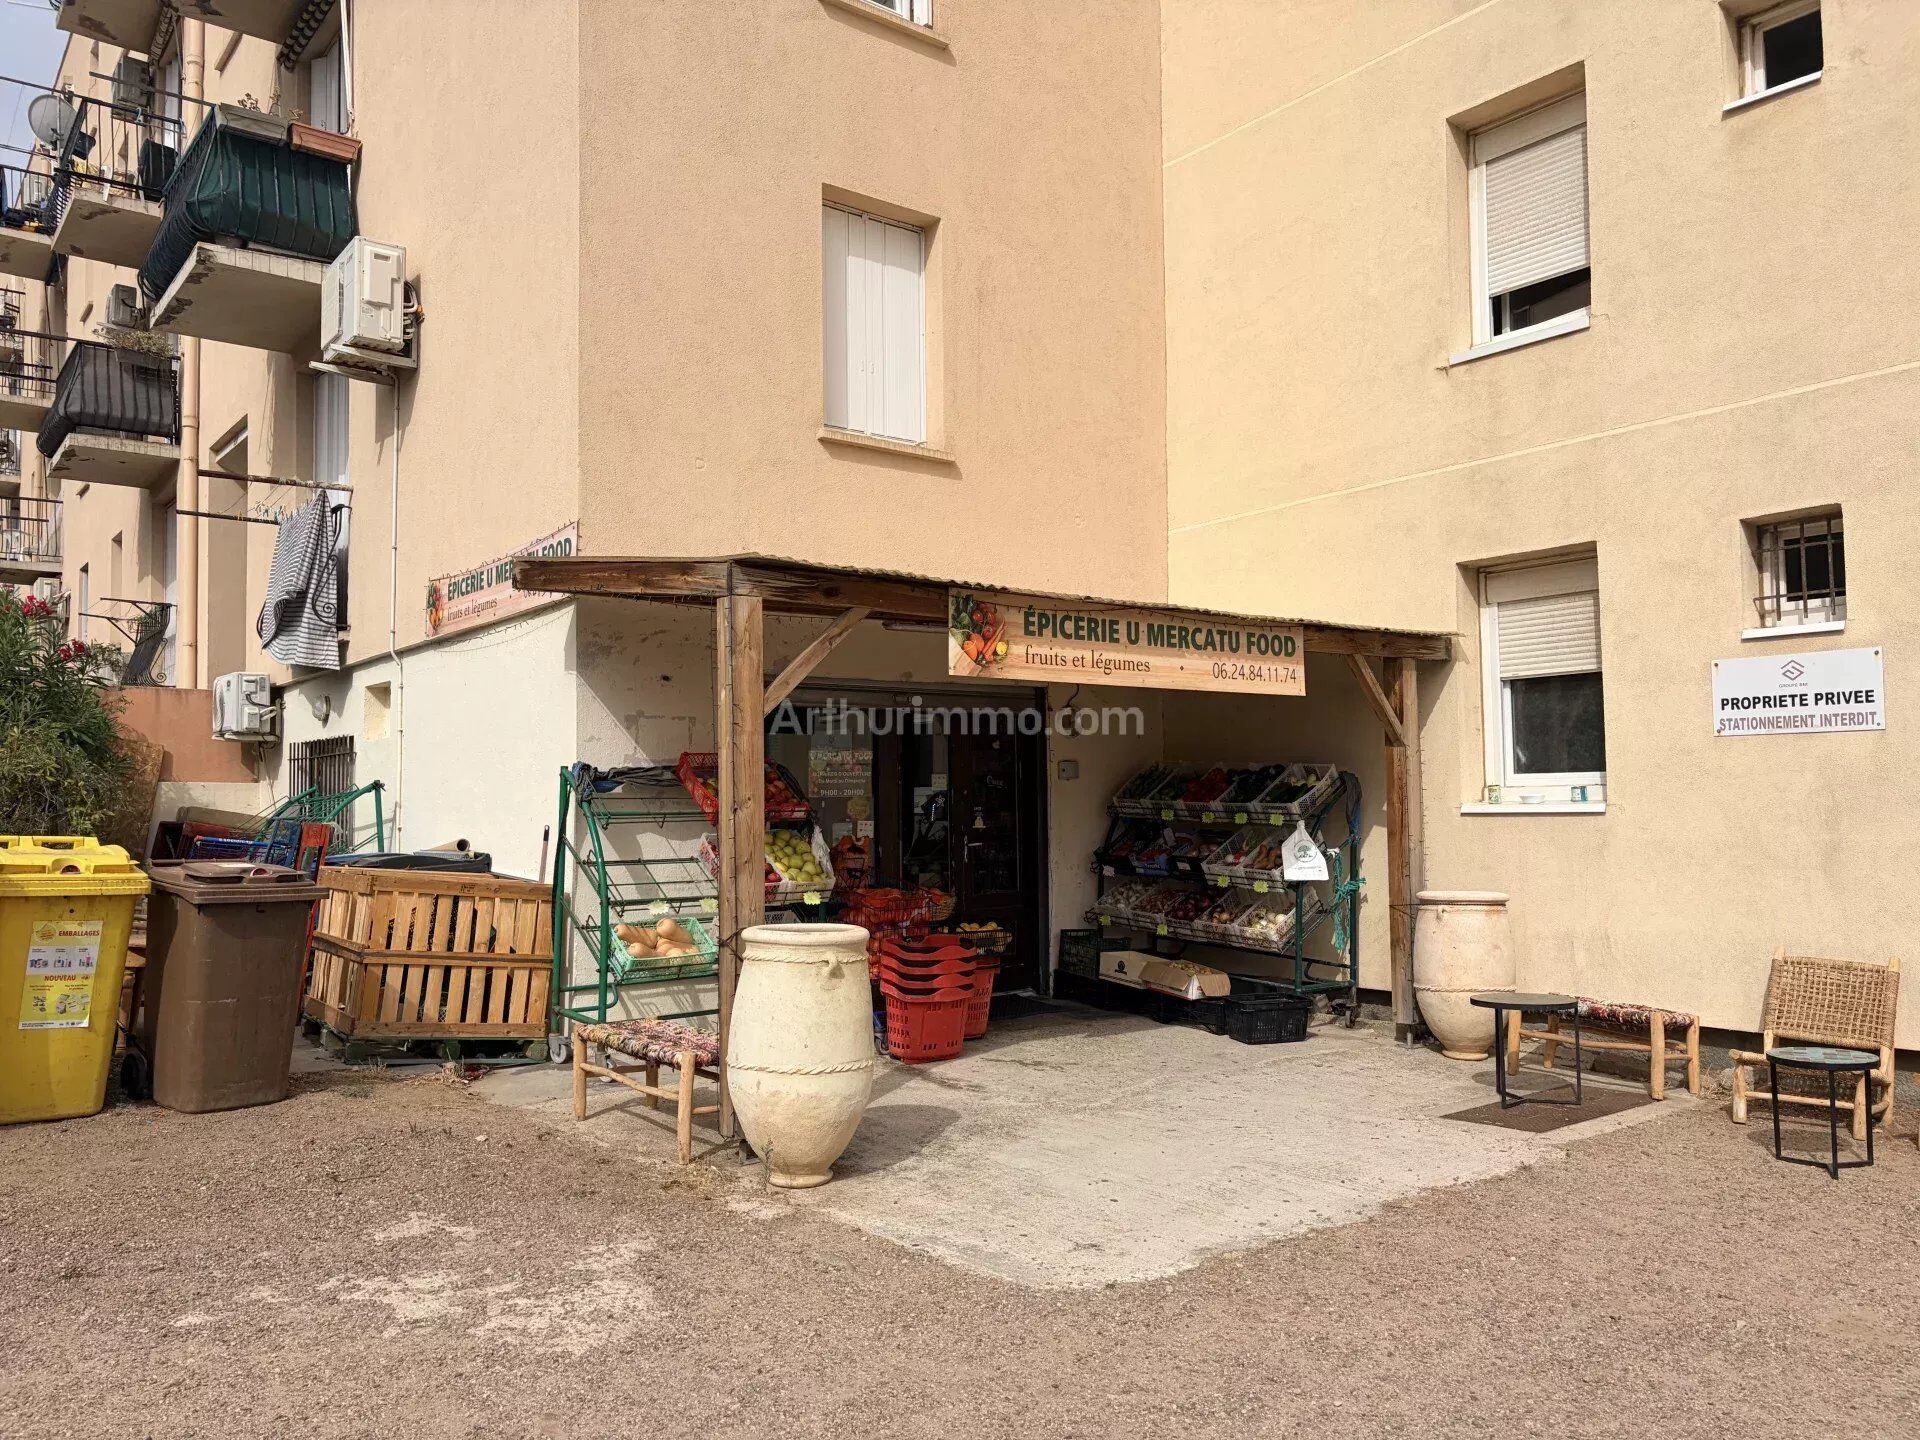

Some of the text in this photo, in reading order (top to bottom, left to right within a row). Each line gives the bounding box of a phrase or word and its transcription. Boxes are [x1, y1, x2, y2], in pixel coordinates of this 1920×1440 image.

[447, 570, 485, 602] ÉPICERIE
[487, 567, 493, 588] U
[447, 598, 498, 622] fruits et légumes
[1023, 604, 1297, 658] ÉPICERIE U MERCATU FOOD
[1025, 645, 1151, 676] fruits et légumes
[1212, 661, 1297, 684] 06.24.84.11.74
[1720, 689, 1876, 711] PROPRIETE PRIVEE
[1719, 711, 1877, 731] STATIONNEMENT INTERDIT
